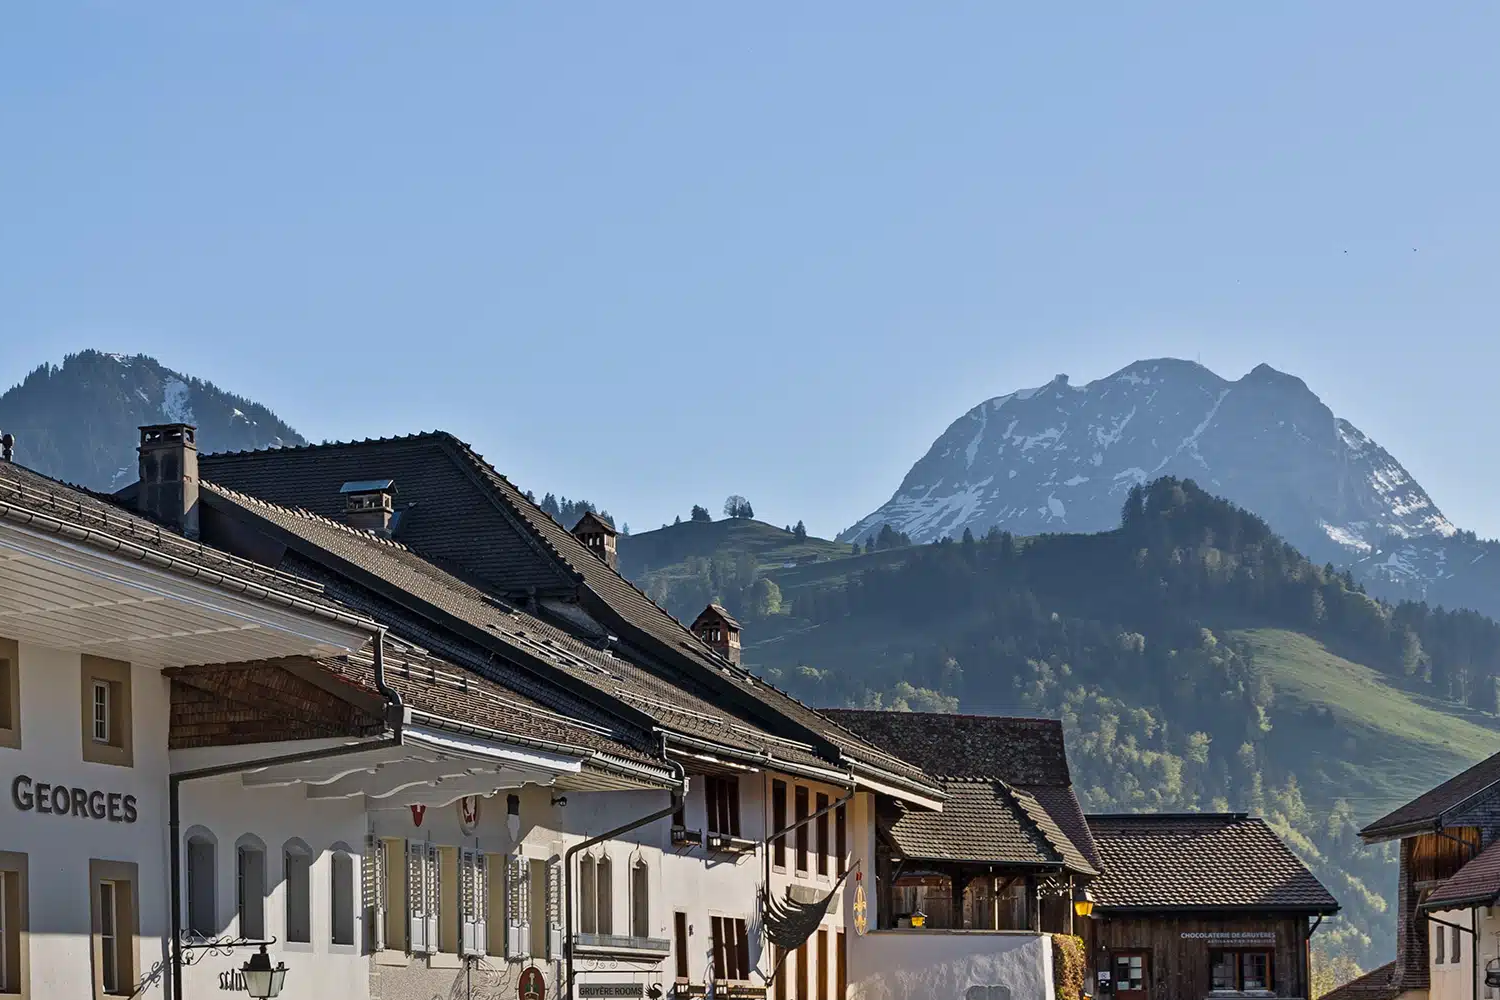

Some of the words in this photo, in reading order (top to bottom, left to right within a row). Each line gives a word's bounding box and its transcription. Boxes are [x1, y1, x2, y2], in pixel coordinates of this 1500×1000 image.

[10, 774, 138, 824] GEORGES
[579, 986, 613, 997] GRUYÈRE
[614, 983, 643, 996] ROOMS
